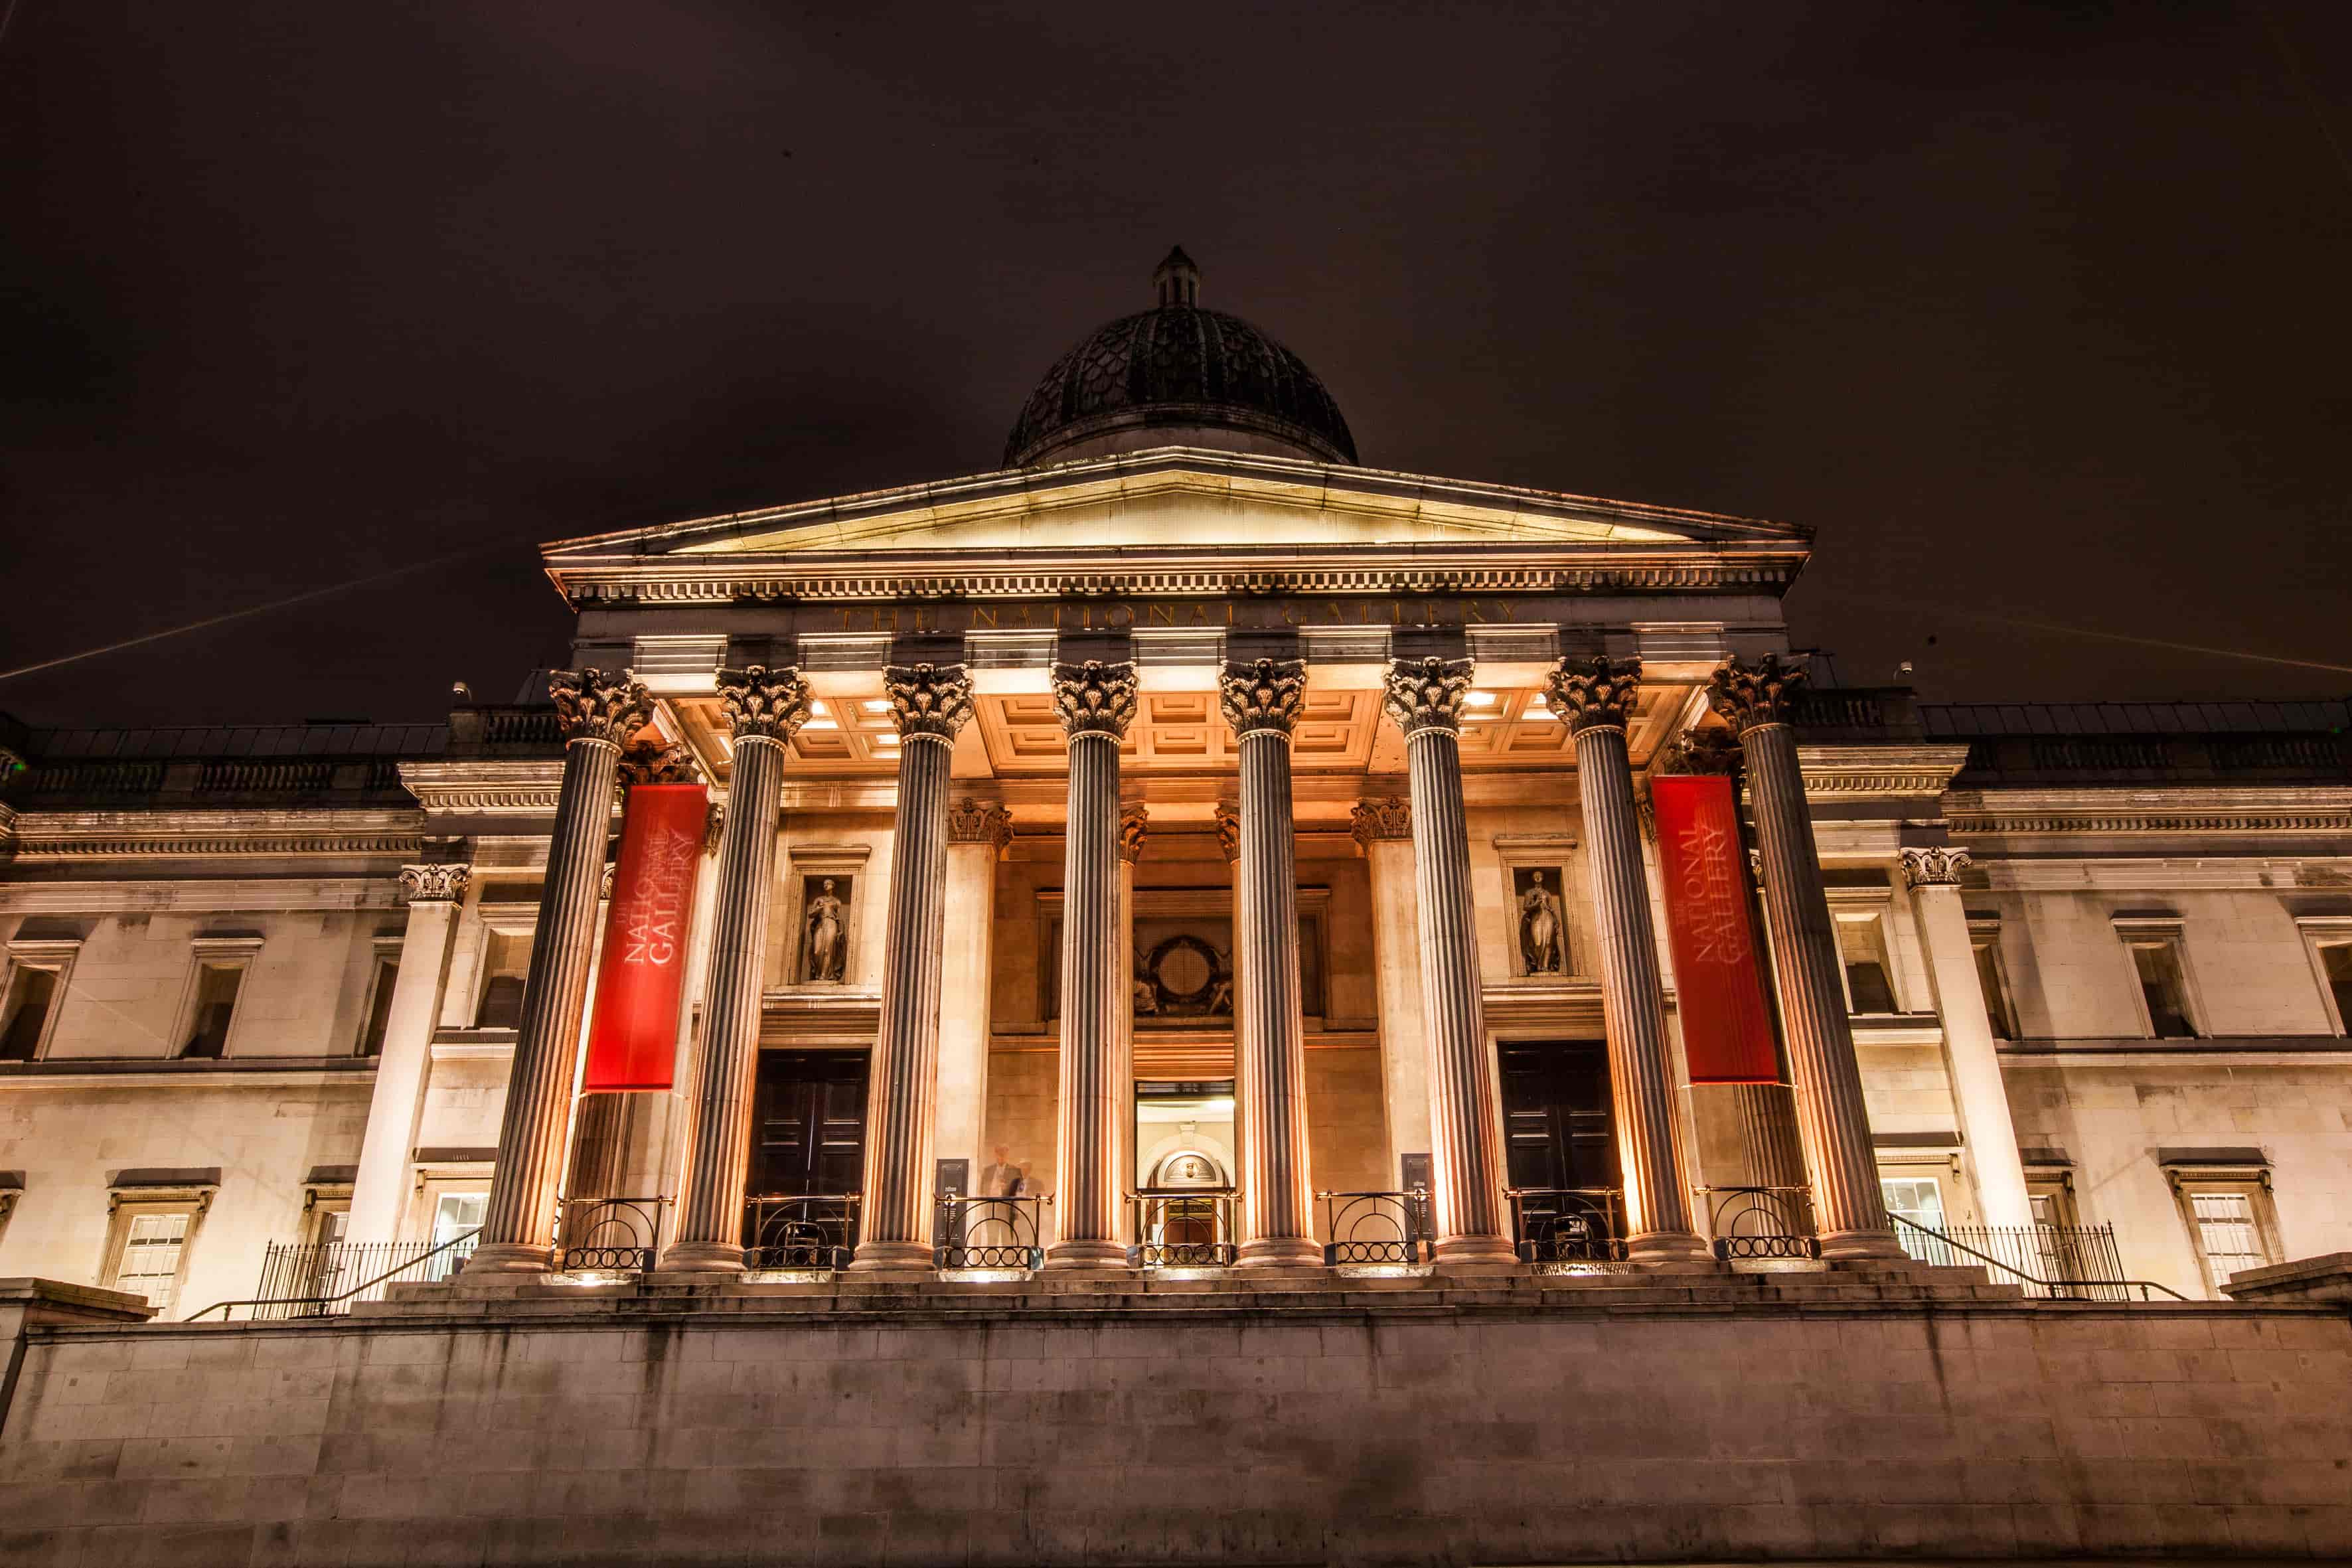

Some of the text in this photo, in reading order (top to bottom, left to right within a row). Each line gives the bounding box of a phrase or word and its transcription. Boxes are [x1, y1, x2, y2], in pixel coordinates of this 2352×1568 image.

[832, 600, 1516, 629] THE NATIONAL GALLERY
[624, 828, 670, 965] NATIONAL
[649, 828, 696, 965] GALLERY
[1679, 823, 1715, 963] NATIONAL
[1701, 823, 1745, 964] GALLERY
